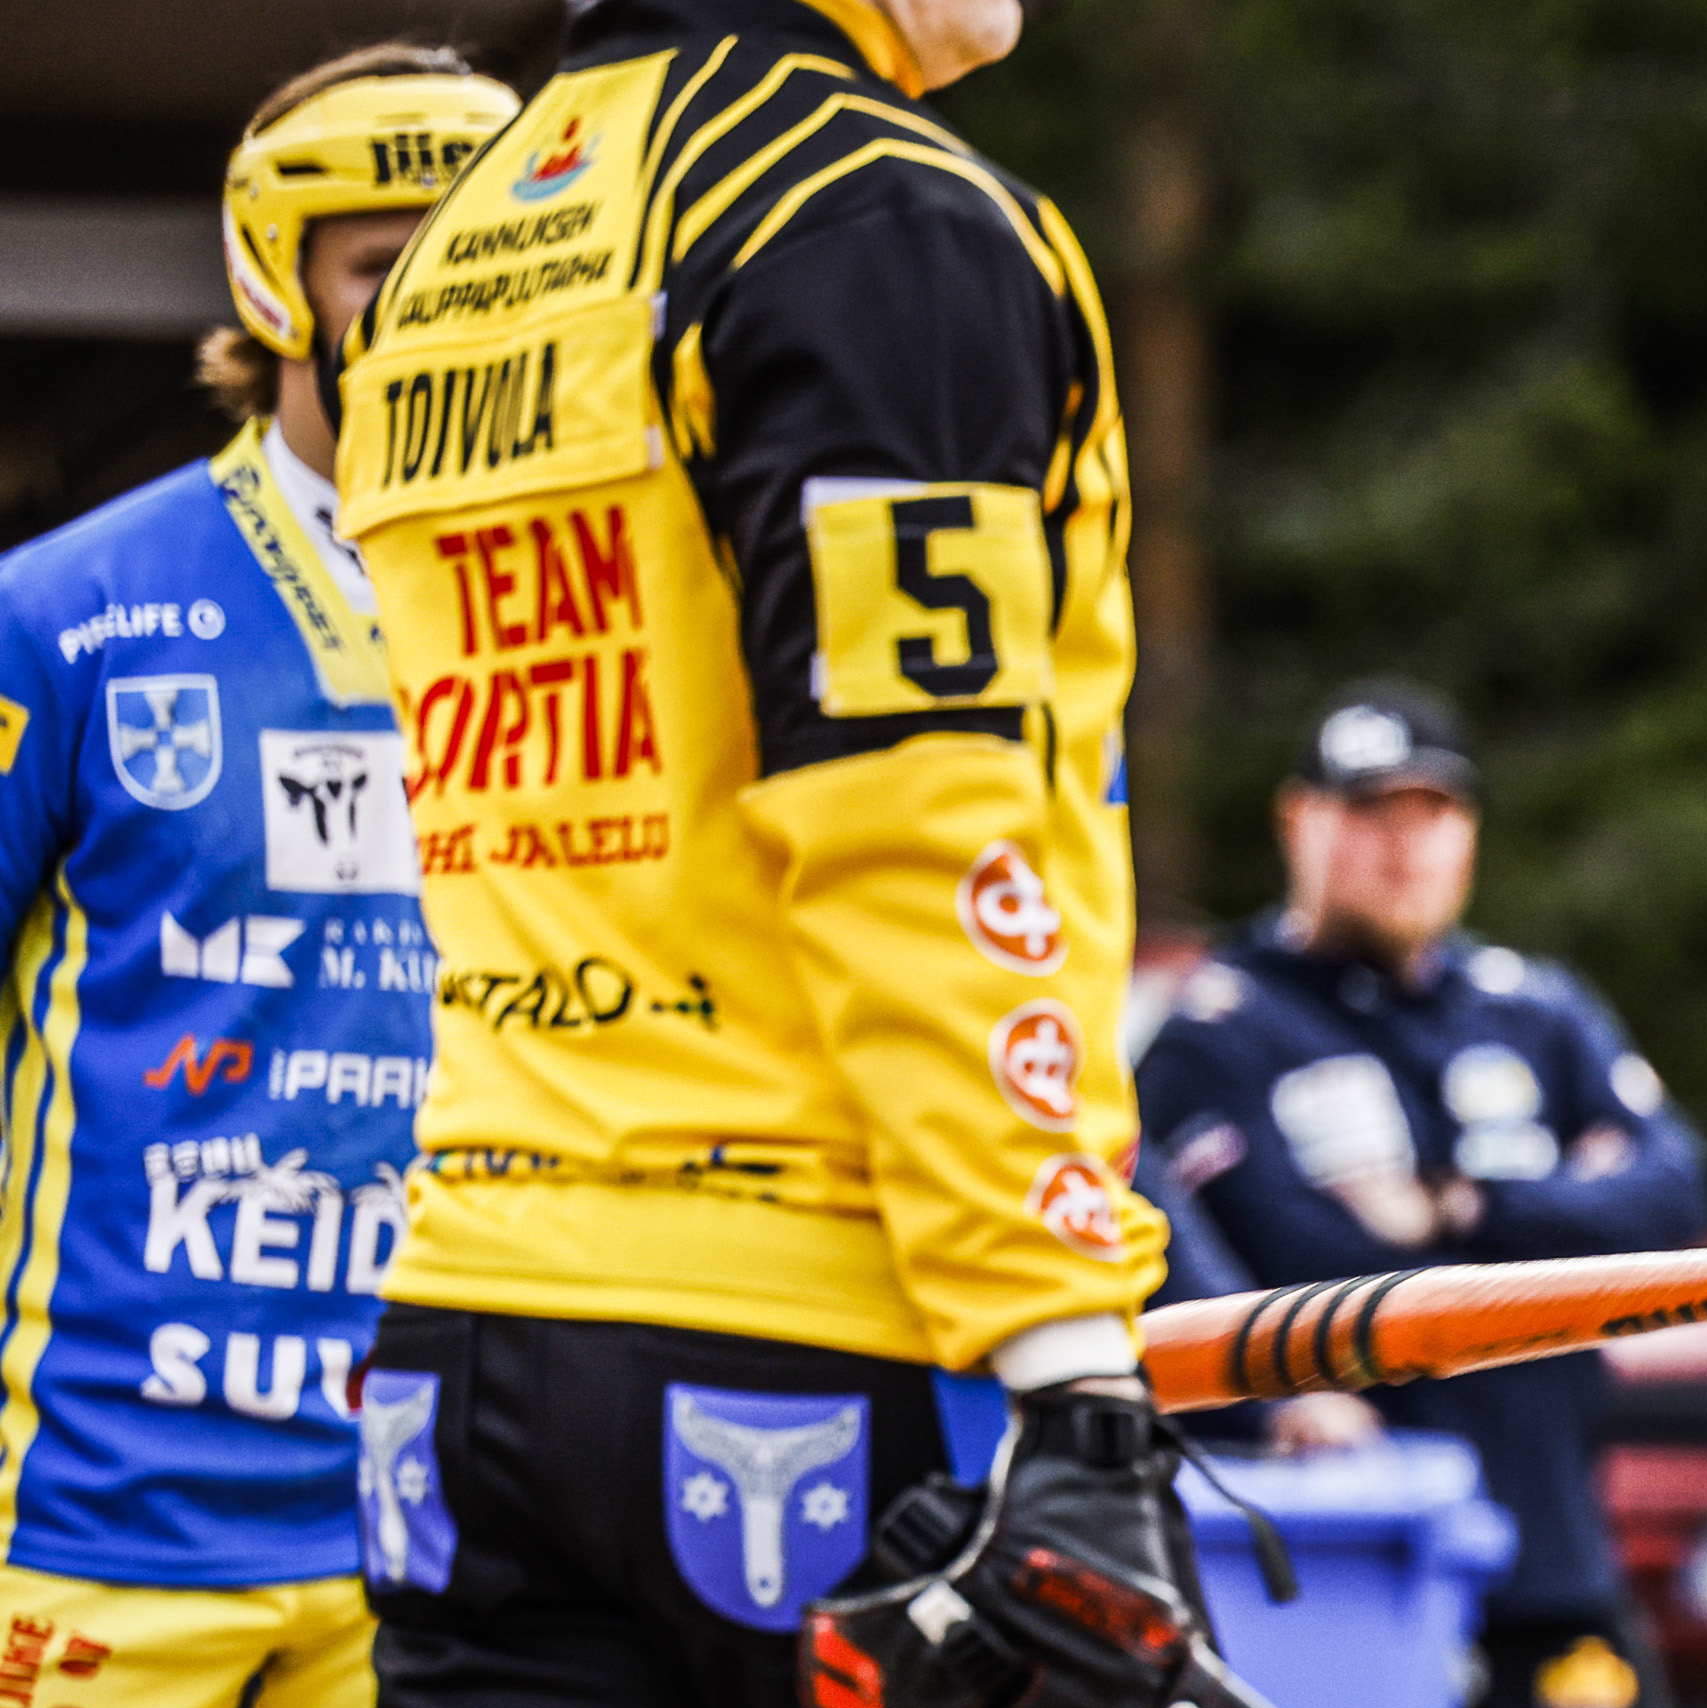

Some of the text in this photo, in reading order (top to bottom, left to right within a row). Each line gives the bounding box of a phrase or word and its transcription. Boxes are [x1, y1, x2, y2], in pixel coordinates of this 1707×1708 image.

[434, 502, 643, 657] TEAM
[890, 494, 999, 699] 5
[396, 647, 663, 806] ORTIA
